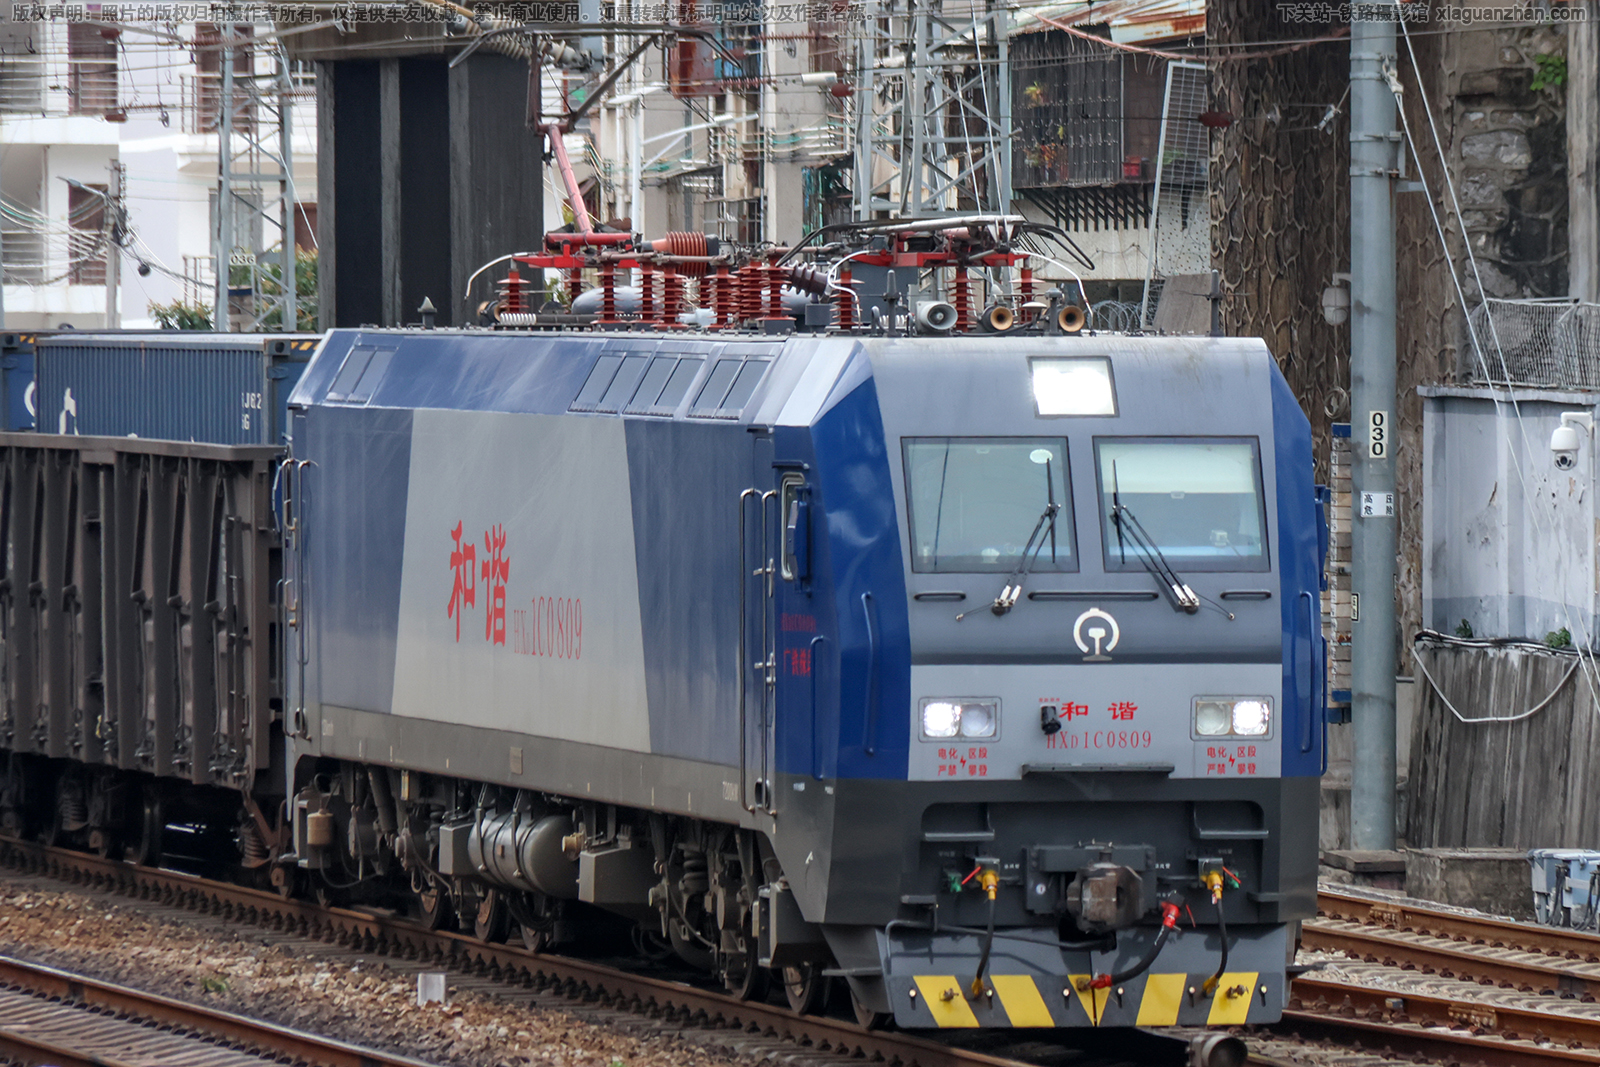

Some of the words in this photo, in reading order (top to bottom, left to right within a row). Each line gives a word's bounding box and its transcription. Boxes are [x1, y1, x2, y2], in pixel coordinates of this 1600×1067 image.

[1372, 412, 1384, 456] 030
[447, 519, 511, 647] 和谐
[1059, 701, 1139, 721] 和谐
